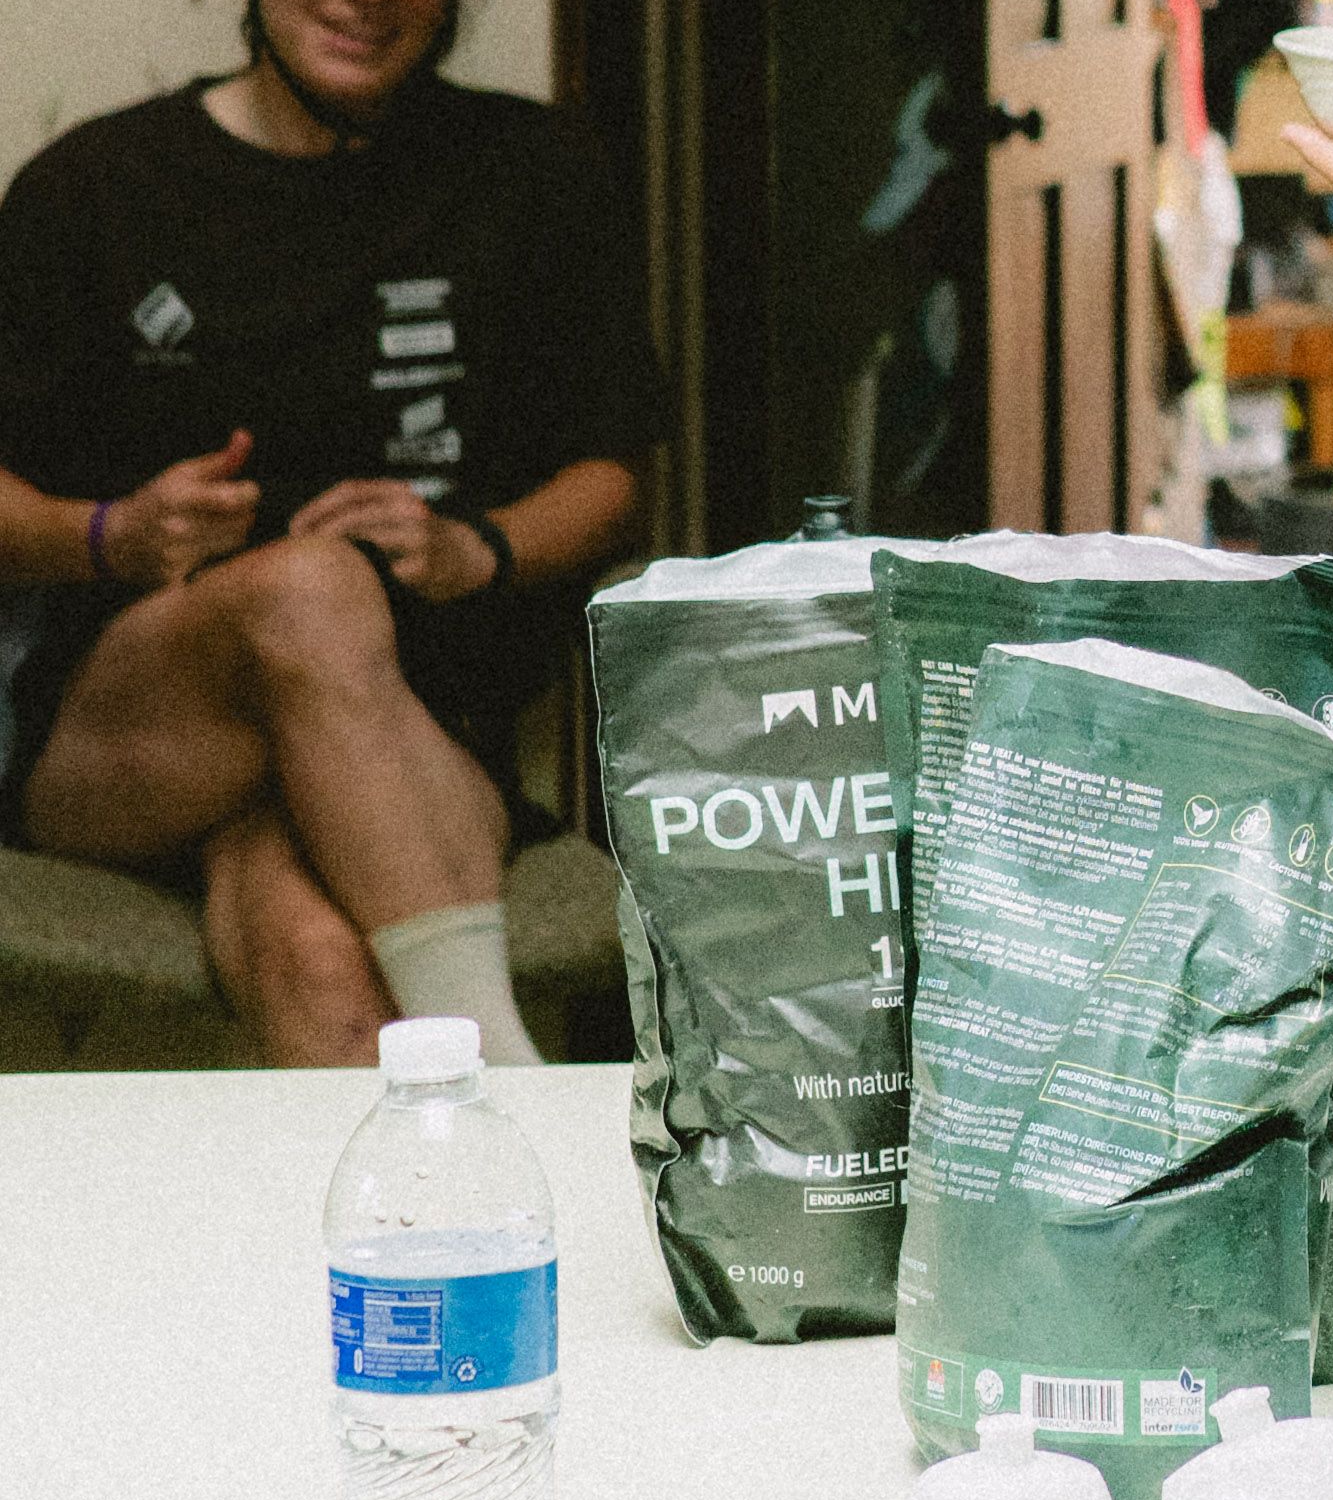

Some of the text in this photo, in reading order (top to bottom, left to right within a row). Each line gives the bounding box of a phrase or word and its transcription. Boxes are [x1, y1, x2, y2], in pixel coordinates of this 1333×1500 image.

[650, 772, 898, 855] POWE
[793, 1072, 842, 1101] With
[1136, 1107, 1159, 1121] [EN]
[1151, 1093, 1168, 1106] BIS
[1202, 1106, 1245, 1125] BEFORE
[805, 1147, 910, 1178] FUELED
[1084, 1138, 1144, 1161] DIRECTIONS
[1145, 1154, 1164, 1167] FOR
[808, 1188, 890, 1207] ENDURANCE
[749, 1266, 789, 1286] 1000
[793, 1270, 805, 1288] g
[1144, 1396, 1202, 1407] MADE FOR
[1144, 1407, 1202, 1416] RECYCLING
